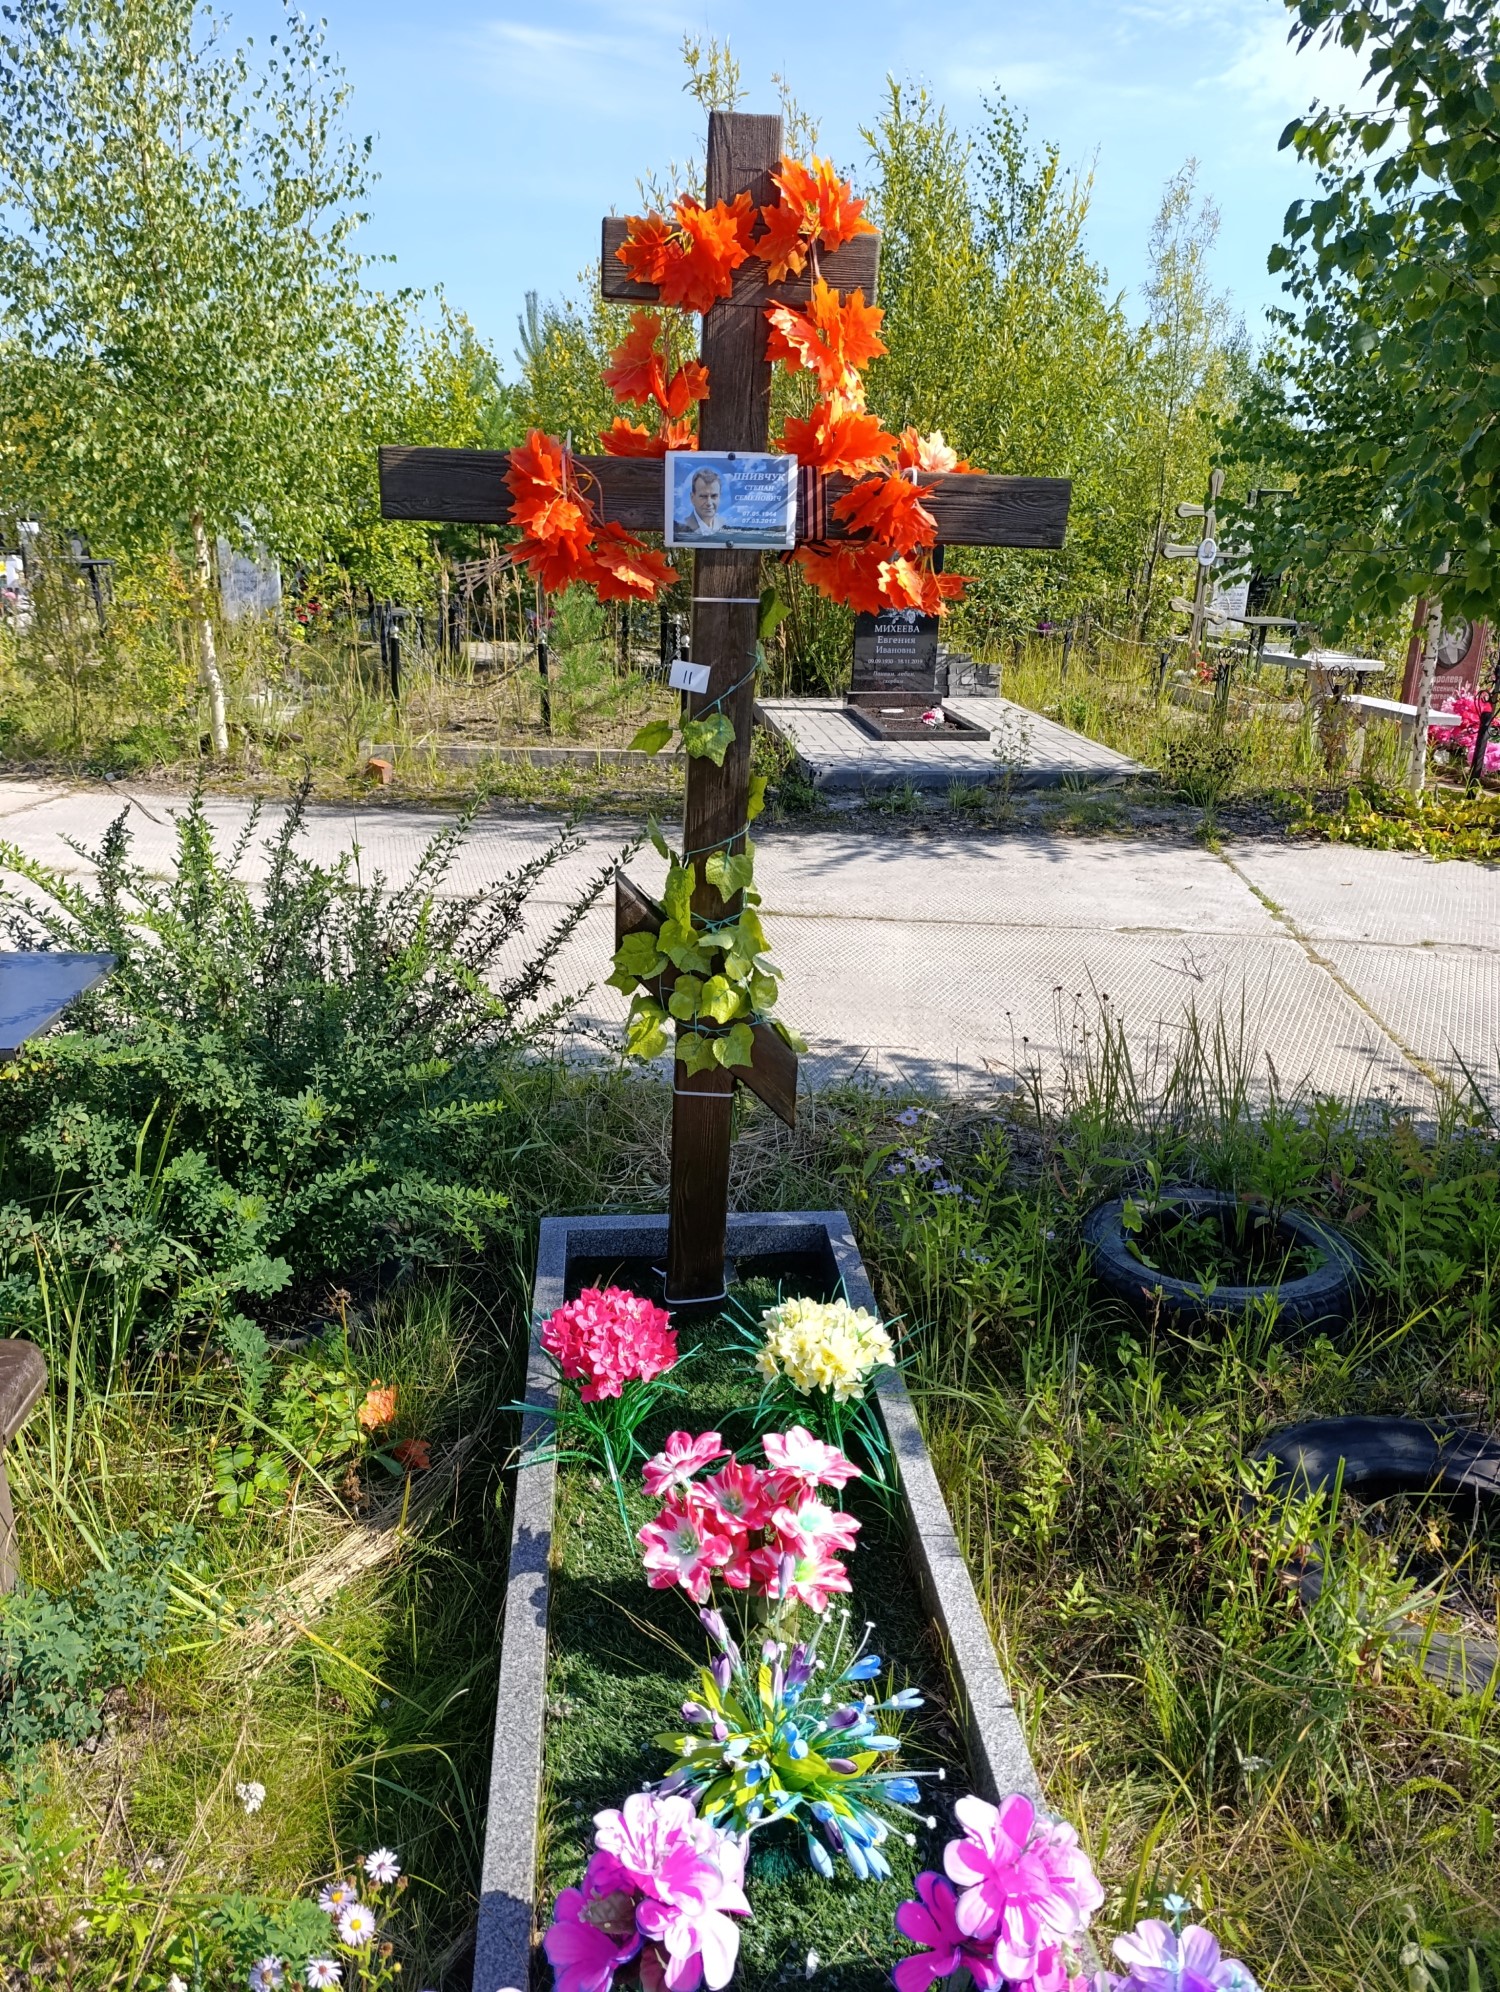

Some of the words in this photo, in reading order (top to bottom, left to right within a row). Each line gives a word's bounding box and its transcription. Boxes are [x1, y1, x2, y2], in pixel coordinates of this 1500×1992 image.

[733, 472, 786, 482] ПНИВЧУК
[744, 484, 775, 492] СТЕПАН
[734, 494, 782, 502] СЕМЕНОВИЧ
[874, 624, 920, 633] МИХЕЕВА
[877, 636, 916, 644] Евгения
[875, 645, 916, 654] Ивановна
